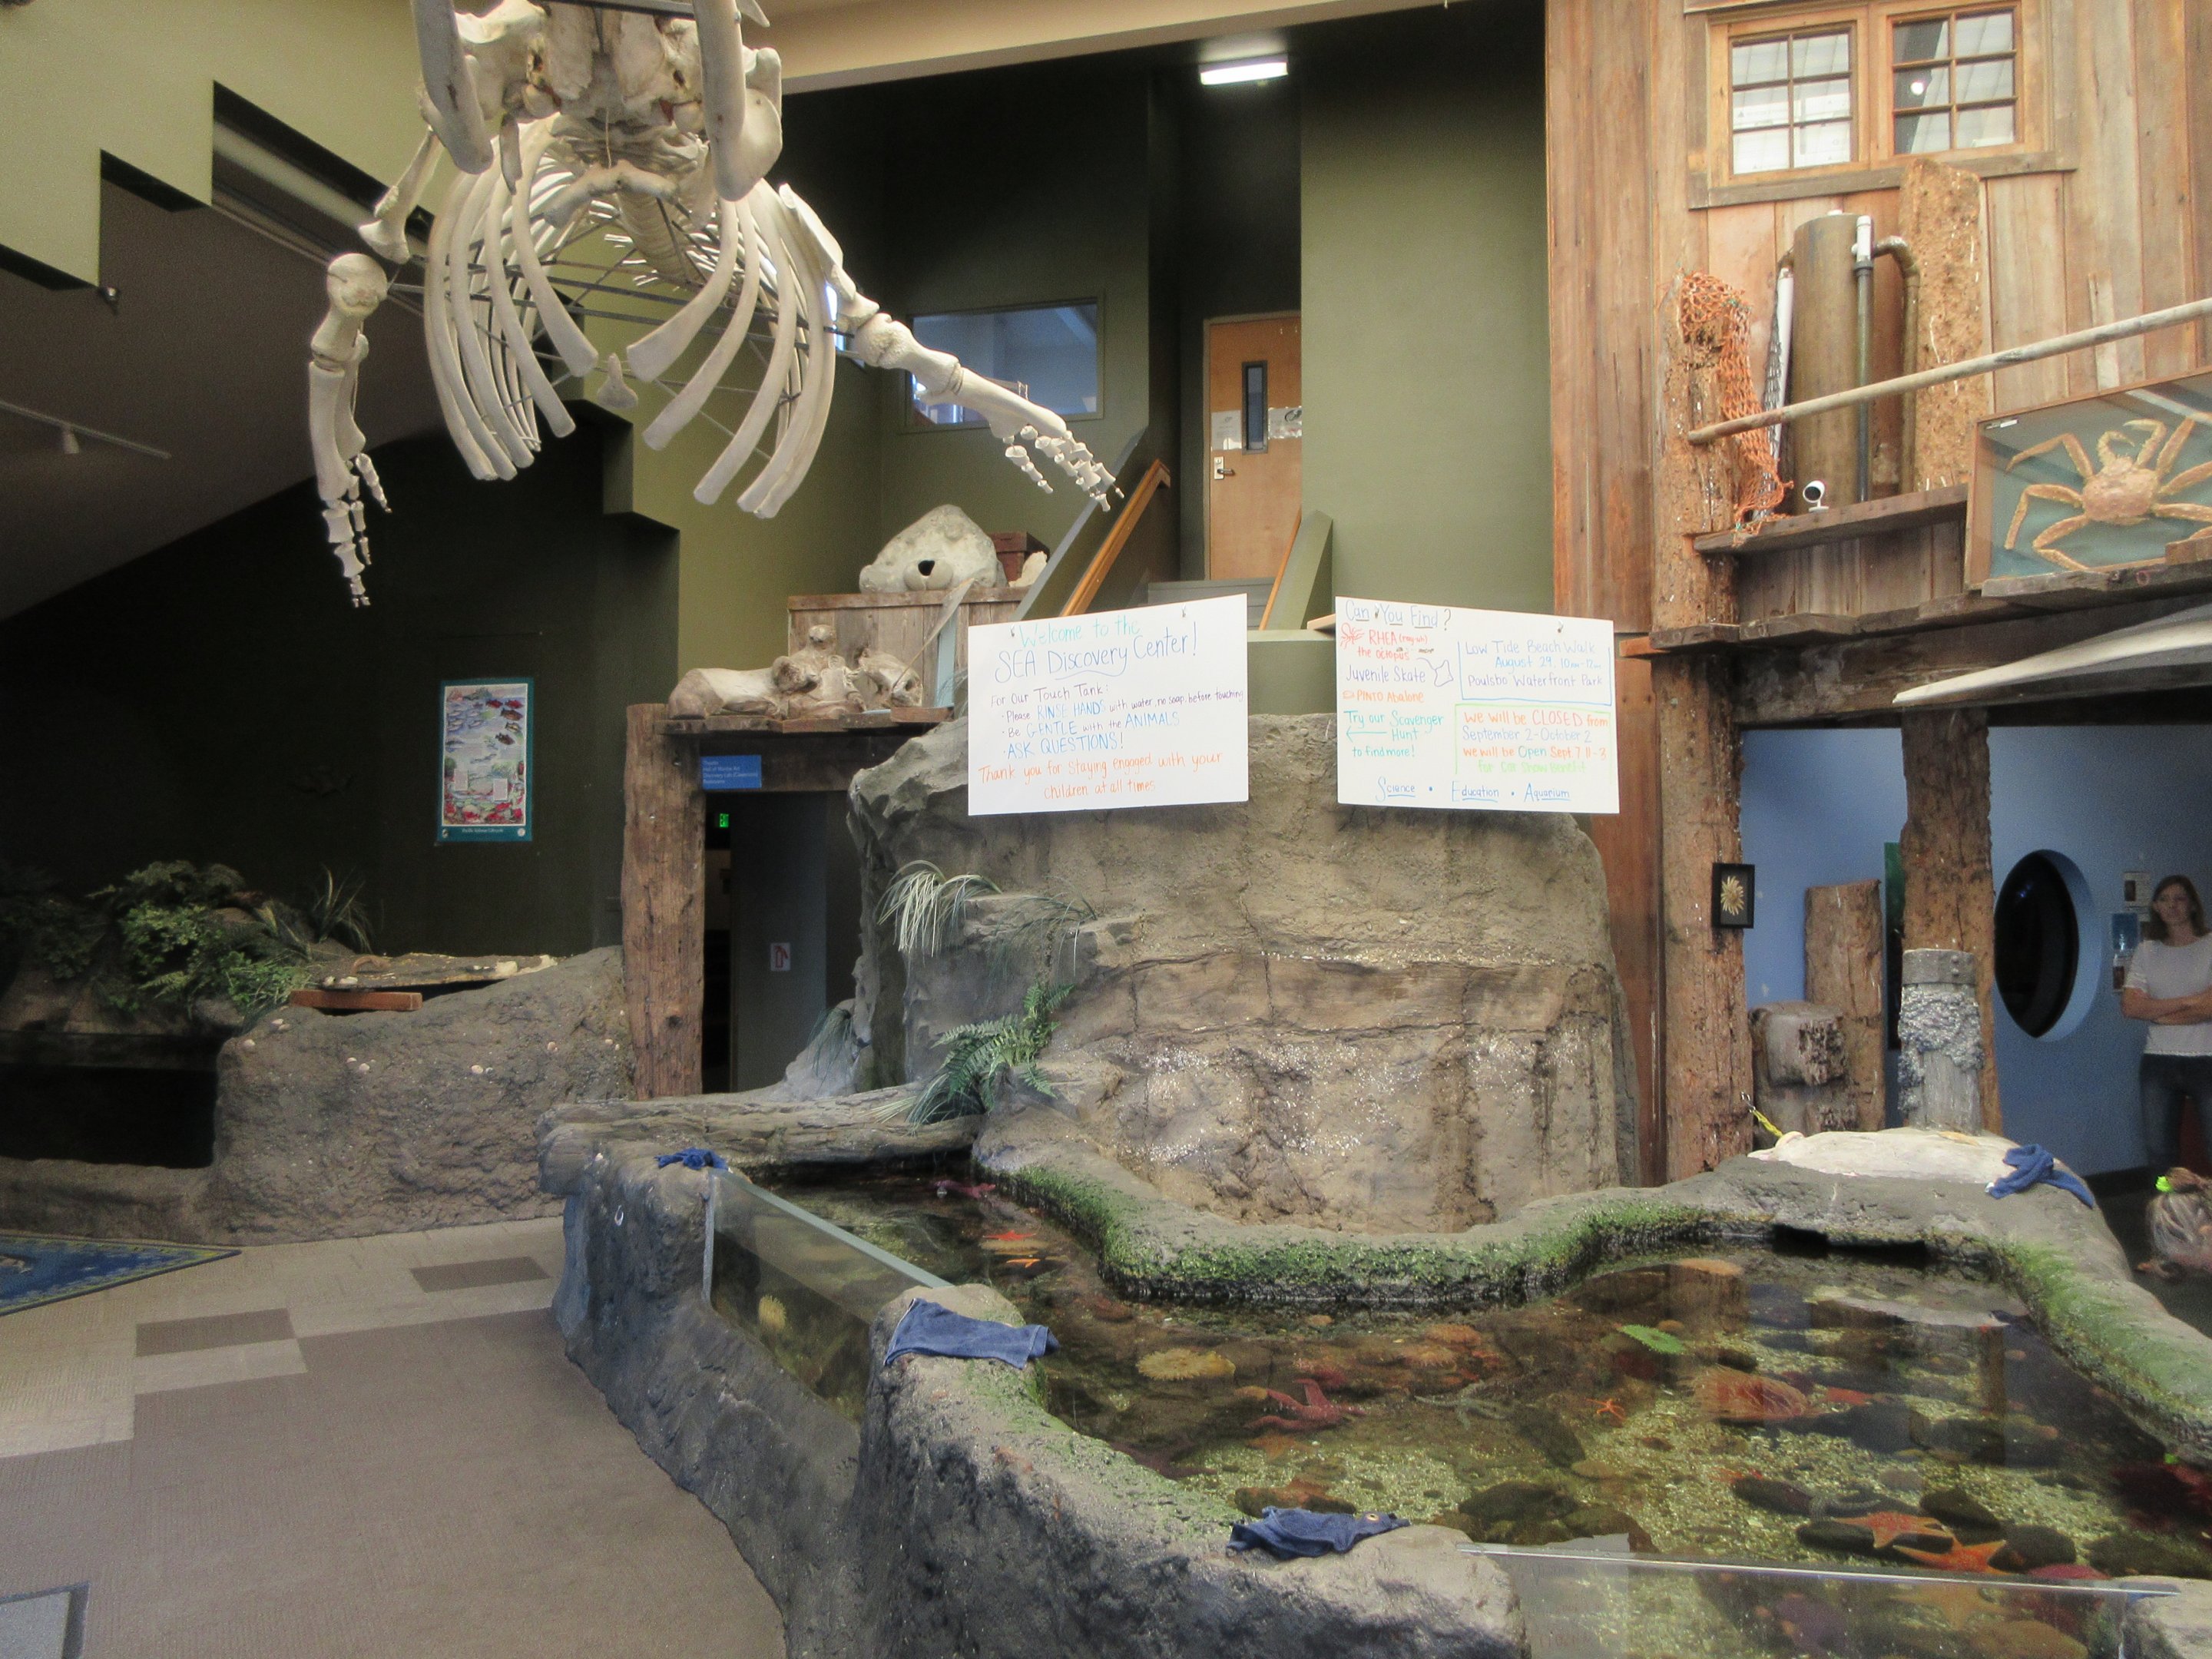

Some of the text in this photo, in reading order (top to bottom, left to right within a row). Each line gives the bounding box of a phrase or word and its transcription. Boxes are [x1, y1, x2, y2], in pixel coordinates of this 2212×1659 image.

[1346, 600, 1369, 621] Can
[1380, 604, 1403, 624] You
[1019, 614, 1141, 648] Welcome to the
[1369, 630, 1397, 646] RHEA
[995, 621, 1197, 683] SEA Discovery Center!
[1357, 646, 1410, 662] the octopus
[1465, 640, 1595, 654] Low Tide Beach Walk
[1495, 656, 1532, 674] August
[1346, 665, 1426, 684] Juvenile Skate
[1468, 673, 1602, 687] Poulsbo Waterfront Park
[1011, 693, 1028, 704] Our
[1033, 687, 1070, 702] Touch
[1388, 690, 1425, 703] Abalone
[1007, 710, 1031, 723] Please
[1038, 704, 1068, 720] RINSE
[1074, 700, 1106, 717] HANDS
[1110, 699, 1128, 712] with
[1157, 697, 1166, 705] no
[1188, 691, 1212, 704] before
[1214, 687, 1244, 702] touching
[1008, 711, 1180, 738] Be GENTLE with the ANIMALS
[1343, 710, 1444, 733] Try our Scavenger
[1488, 710, 1509, 724] will
[1513, 711, 1526, 725] be
[1532, 710, 1583, 726] CLOSED
[1587, 714, 1608, 727] from
[1392, 728, 1419, 741] Hunt
[1462, 725, 1520, 742] September
[1584, 730, 1591, 743] 2
[1007, 732, 1123, 759] ASK QUESTIONS!
[1353, 747, 1363, 757] to
[1366, 746, 1384, 757] find
[1480, 747, 1498, 757] will
[1502, 747, 1515, 757] be
[1518, 745, 1547, 759] Open
[979, 764, 1015, 783] Thank
[1024, 766, 1041, 785] you
[1048, 760, 1061, 776] for
[1113, 752, 1152, 774] engaged
[1158, 750, 1185, 768] with
[1192, 752, 1222, 773] your
[1045, 778, 1156, 799] children at all times
[1376, 777, 1570, 802] Science Education Aquarium
